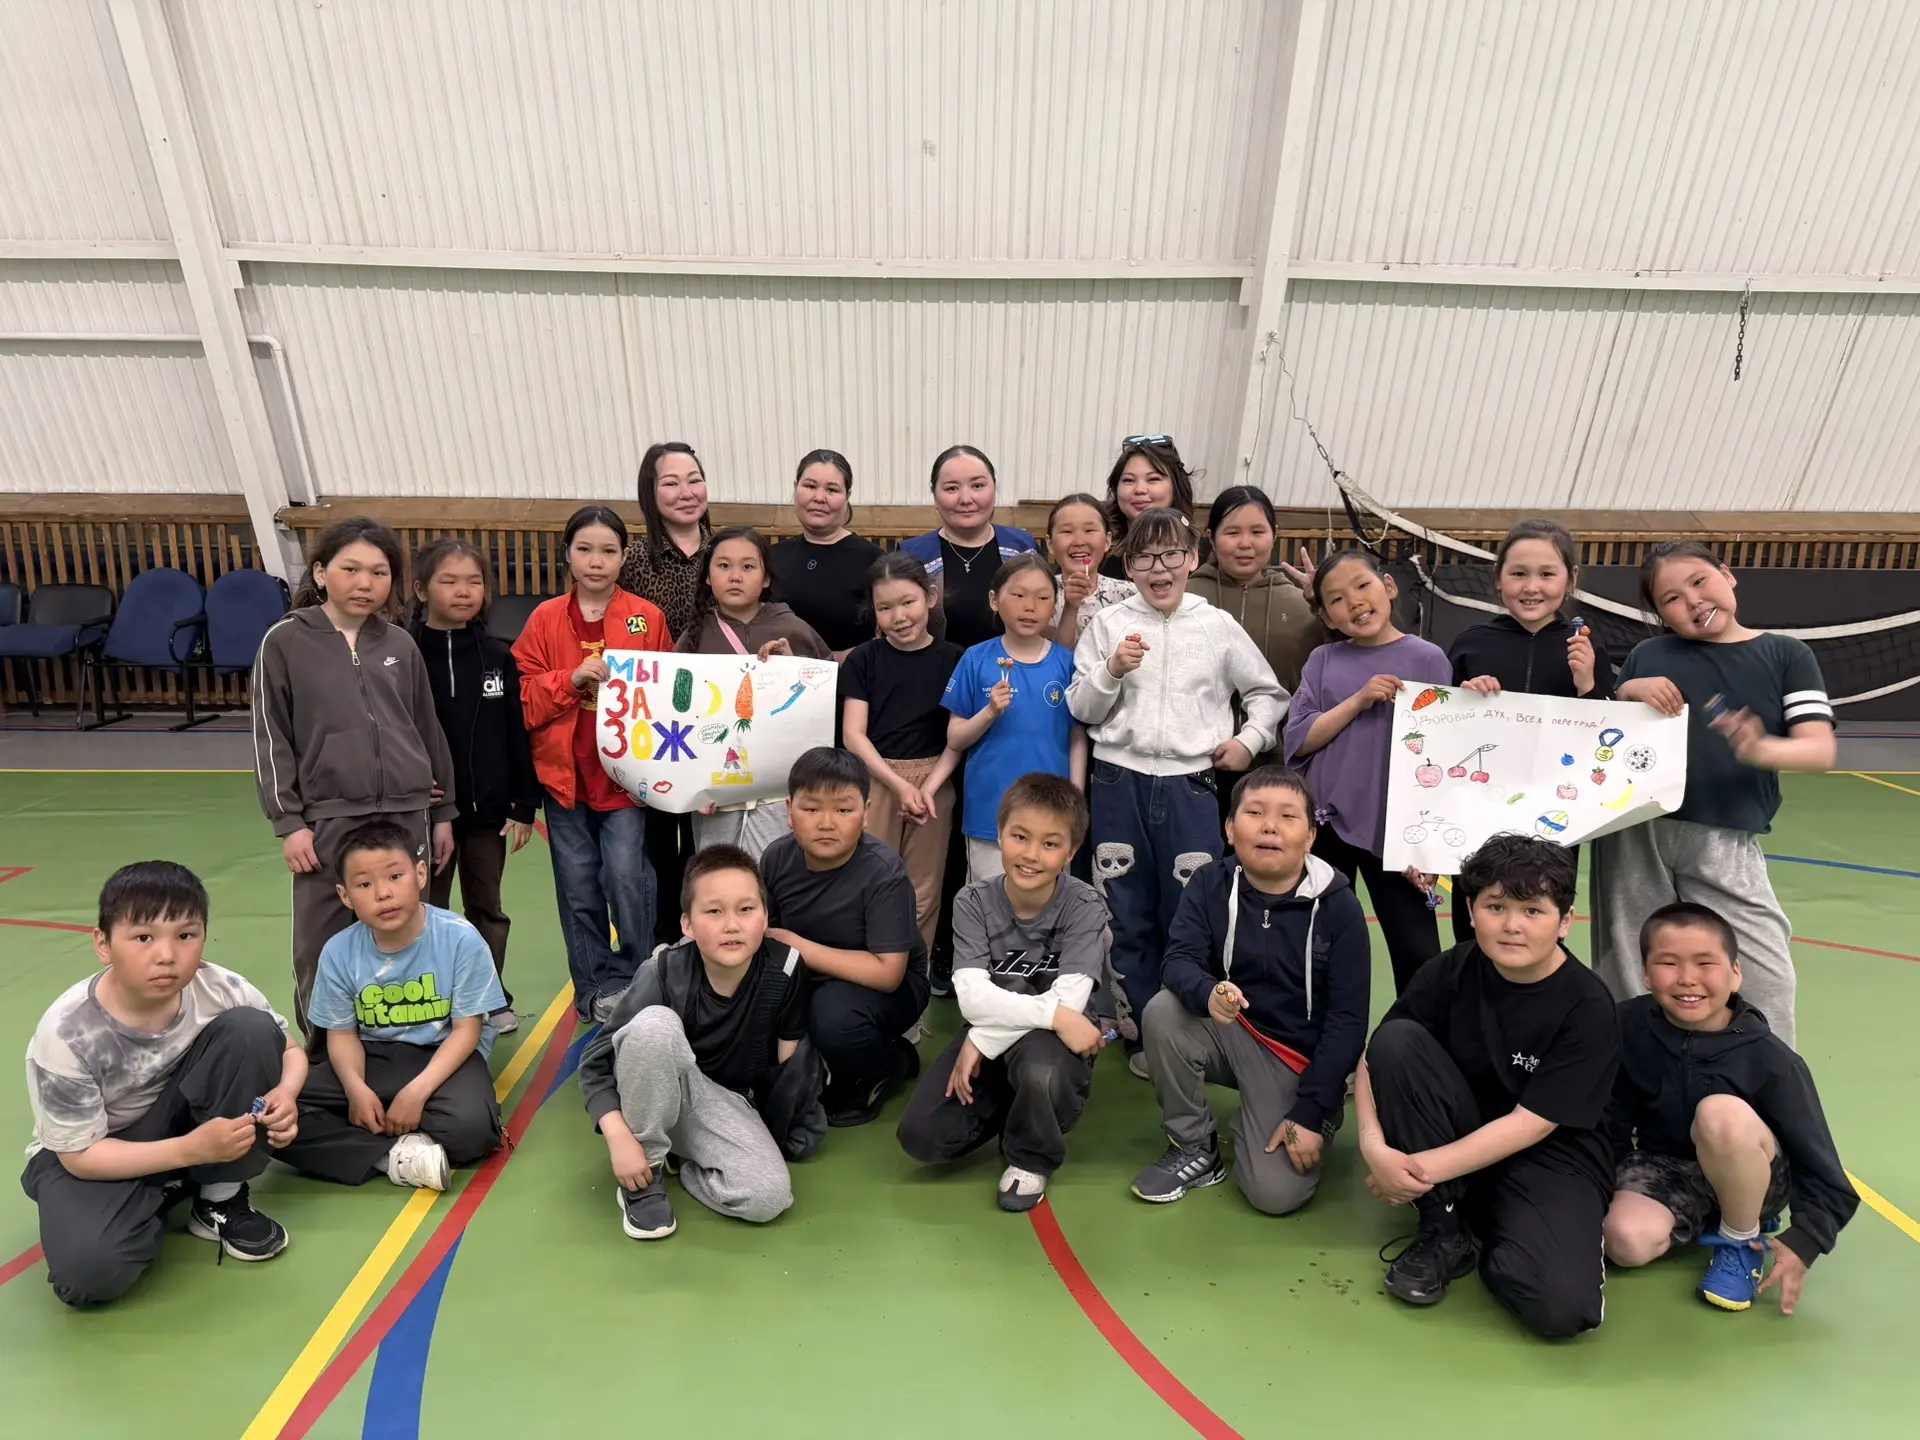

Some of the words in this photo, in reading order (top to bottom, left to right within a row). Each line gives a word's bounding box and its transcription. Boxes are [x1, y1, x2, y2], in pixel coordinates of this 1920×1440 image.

[627, 616, 648, 633] 26
[607, 655, 659, 683] МЫ
[605, 678, 653, 719] ЗА
[601, 718, 698, 762] ЗОЖ
[361, 972, 437, 1004] cool
